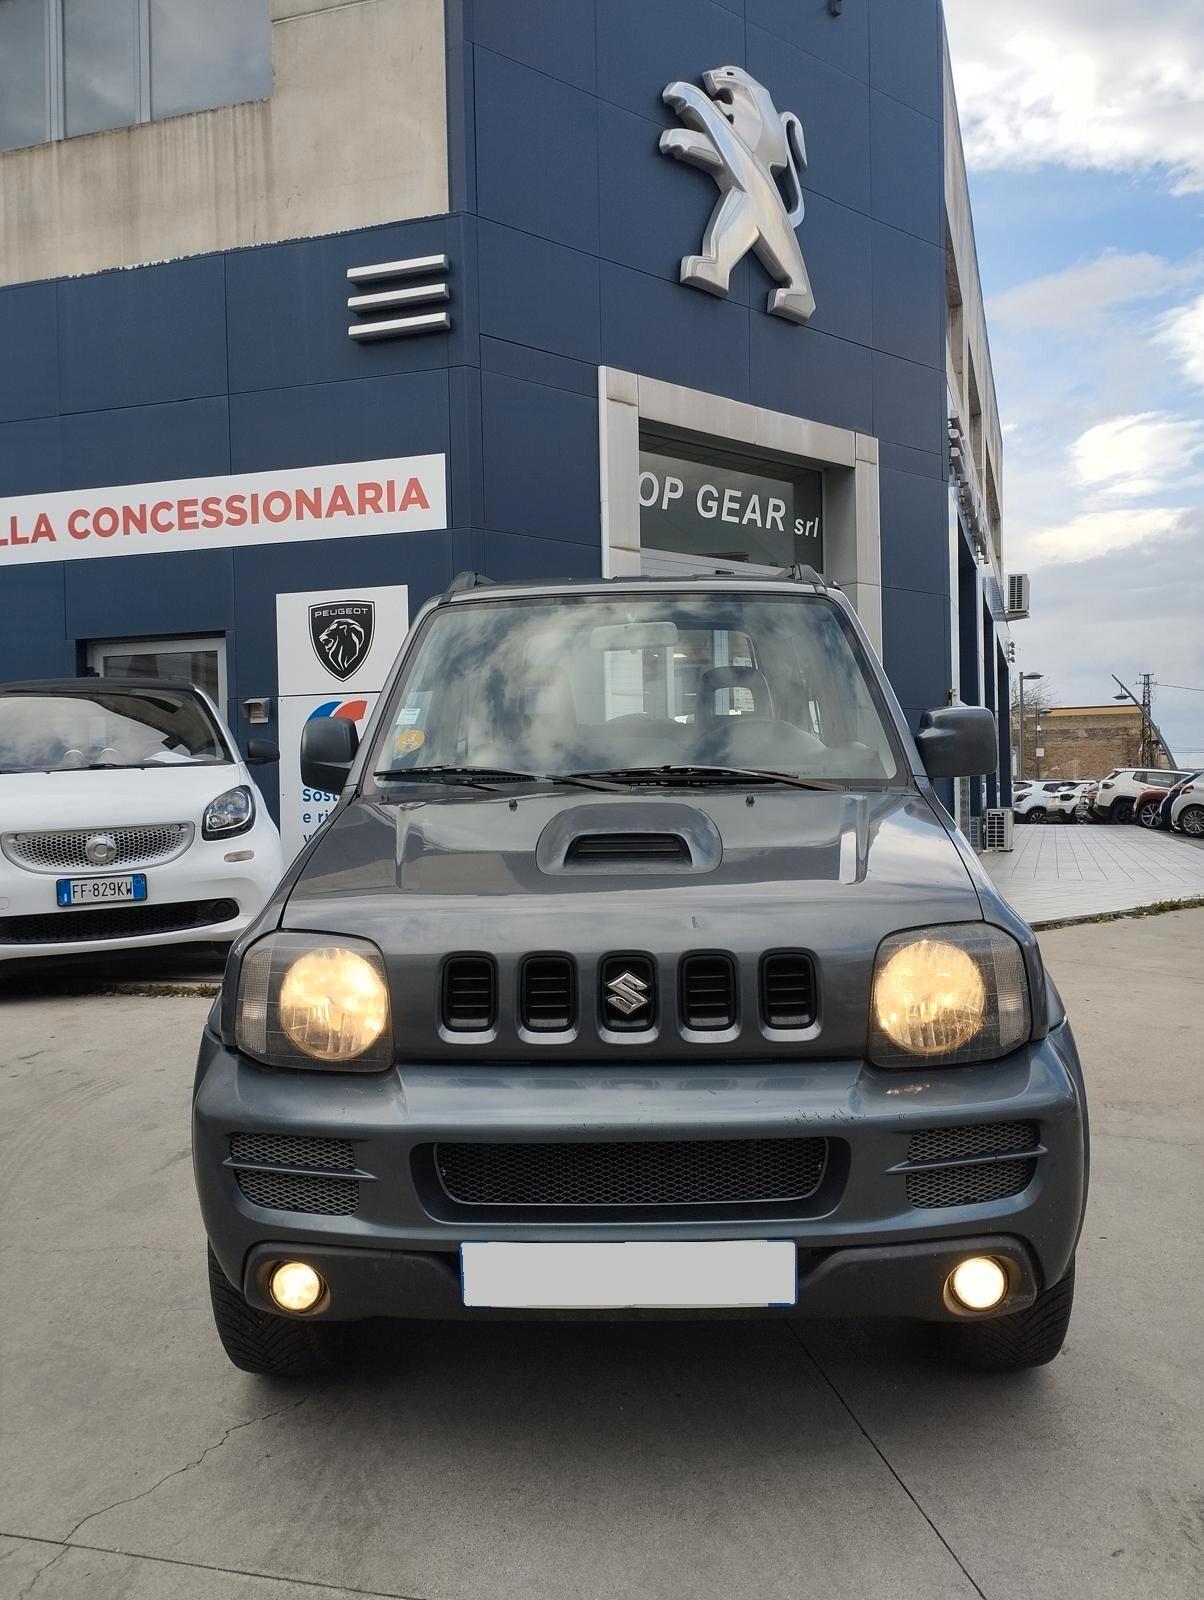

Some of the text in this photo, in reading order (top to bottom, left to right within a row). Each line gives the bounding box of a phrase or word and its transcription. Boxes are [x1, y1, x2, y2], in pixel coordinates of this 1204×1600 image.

[67, 477, 430, 540] CONCESSIONARIA
[696, 484, 786, 532] GEAR
[794, 517, 819, 538] srl
[314, 607, 369, 618] PEUGEOT
[302, 813, 312, 823] e
